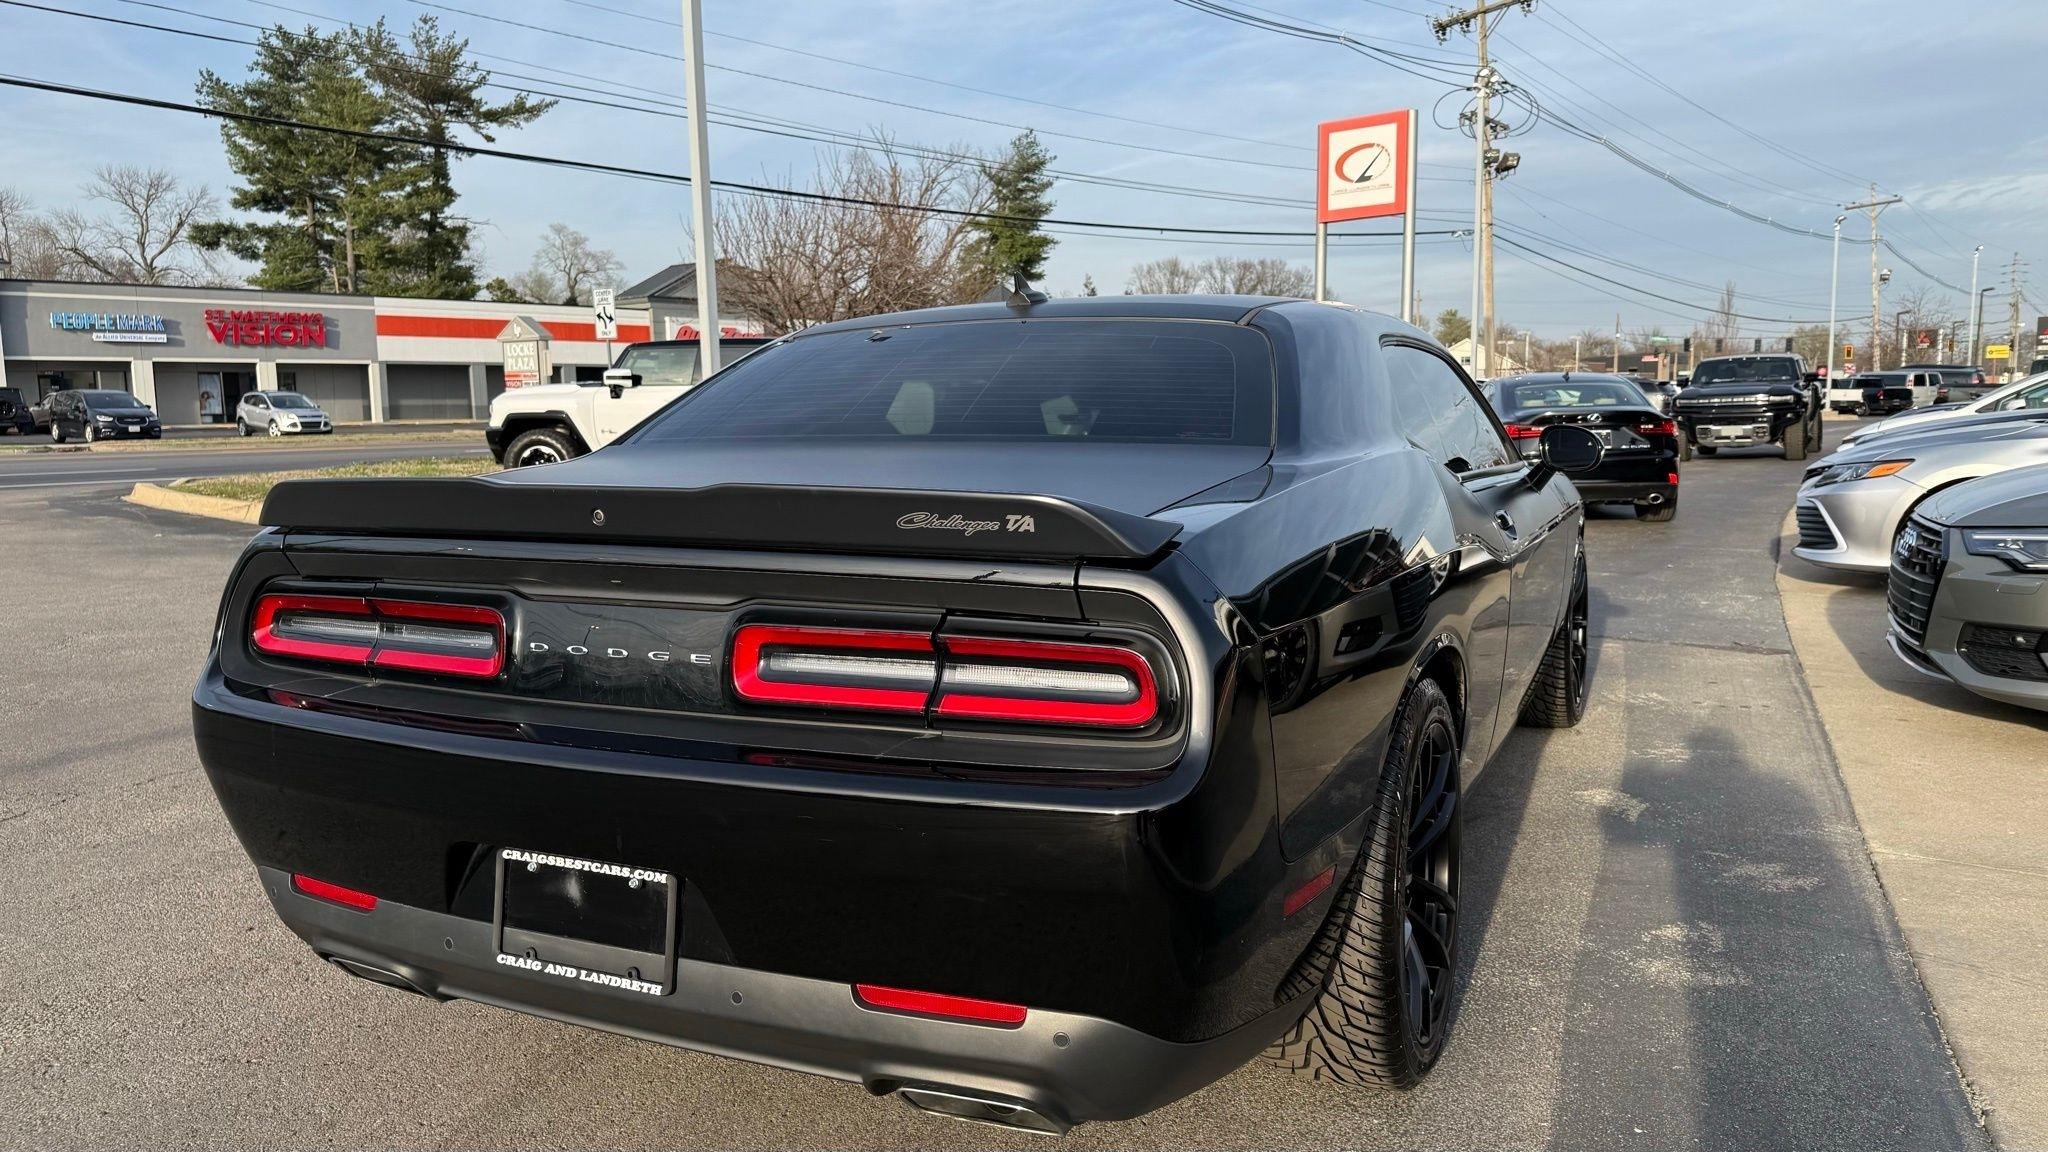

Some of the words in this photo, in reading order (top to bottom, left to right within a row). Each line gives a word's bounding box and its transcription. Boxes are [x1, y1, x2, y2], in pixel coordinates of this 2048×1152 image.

[49, 311, 115, 330] PEOPLE
[116, 313, 165, 331] MARK
[205, 321, 326, 348] VISION
[506, 343, 535, 356] LOCKE
[507, 356, 535, 370] PLAZA
[896, 511, 1000, 537] Challenger
[1005, 514, 1036, 533] T/A
[529, 642, 712, 665] DODGE
[502, 849, 668, 884] CRAIGSBESTCARS.COM
[496, 953, 543, 972] CRAIG
[544, 965, 577, 978] AND
[579, 970, 663, 996] LANDRETH
